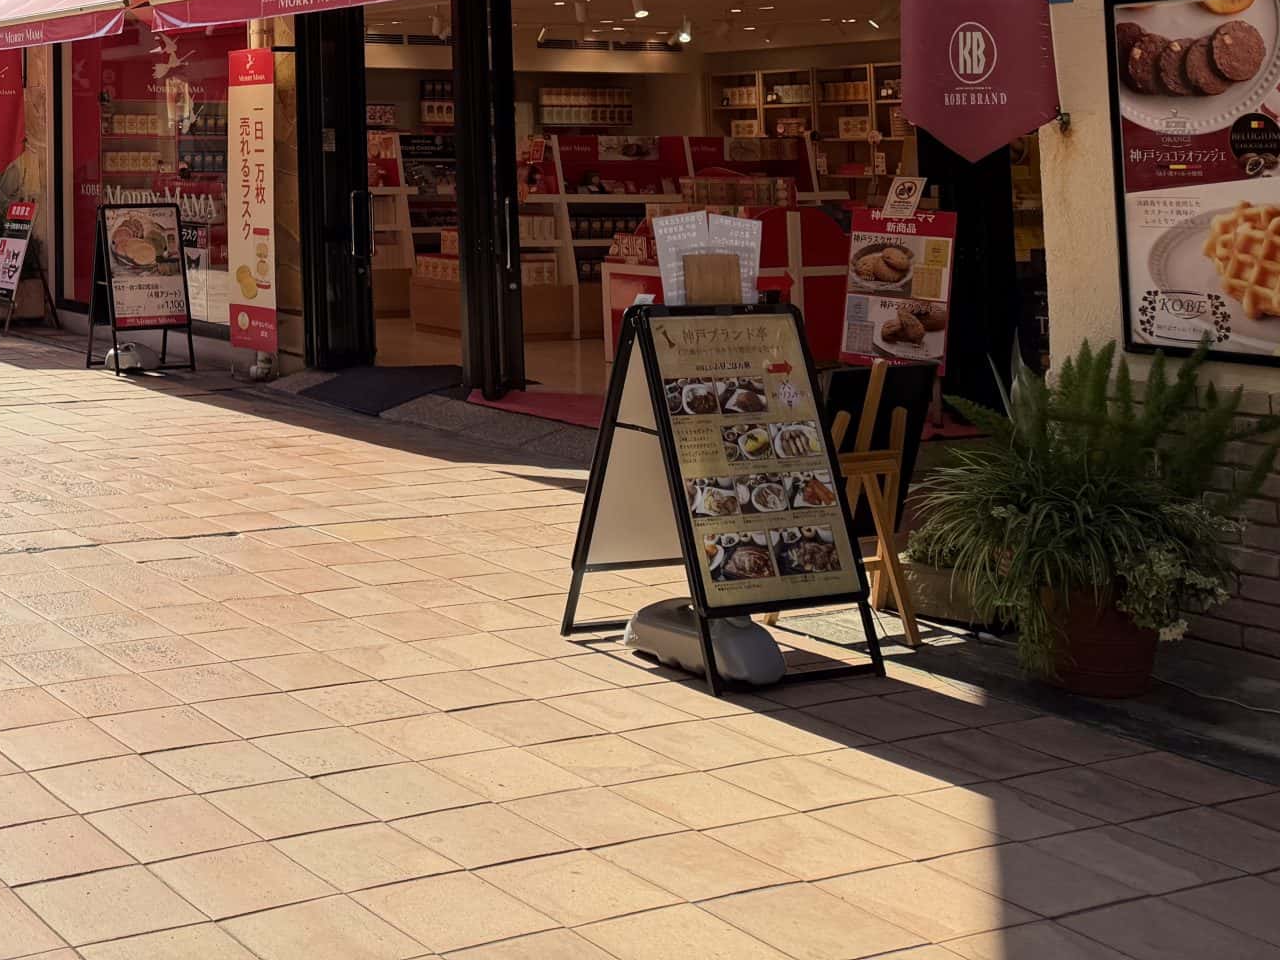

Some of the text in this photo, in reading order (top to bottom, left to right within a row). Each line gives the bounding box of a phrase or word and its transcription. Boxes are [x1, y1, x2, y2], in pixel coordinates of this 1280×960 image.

[958, 31, 986, 75] KB
[944, 91, 1008, 107] KOBE BRAND
[253, 106, 267, 205] 一日一万枚
[1129, 147, 1227, 163] 神戸ショコラオランジェ
[238, 116, 253, 242] 売れるラスク
[886, 221, 917, 234] 新商品
[1158, 297, 1208, 314] KOBE
